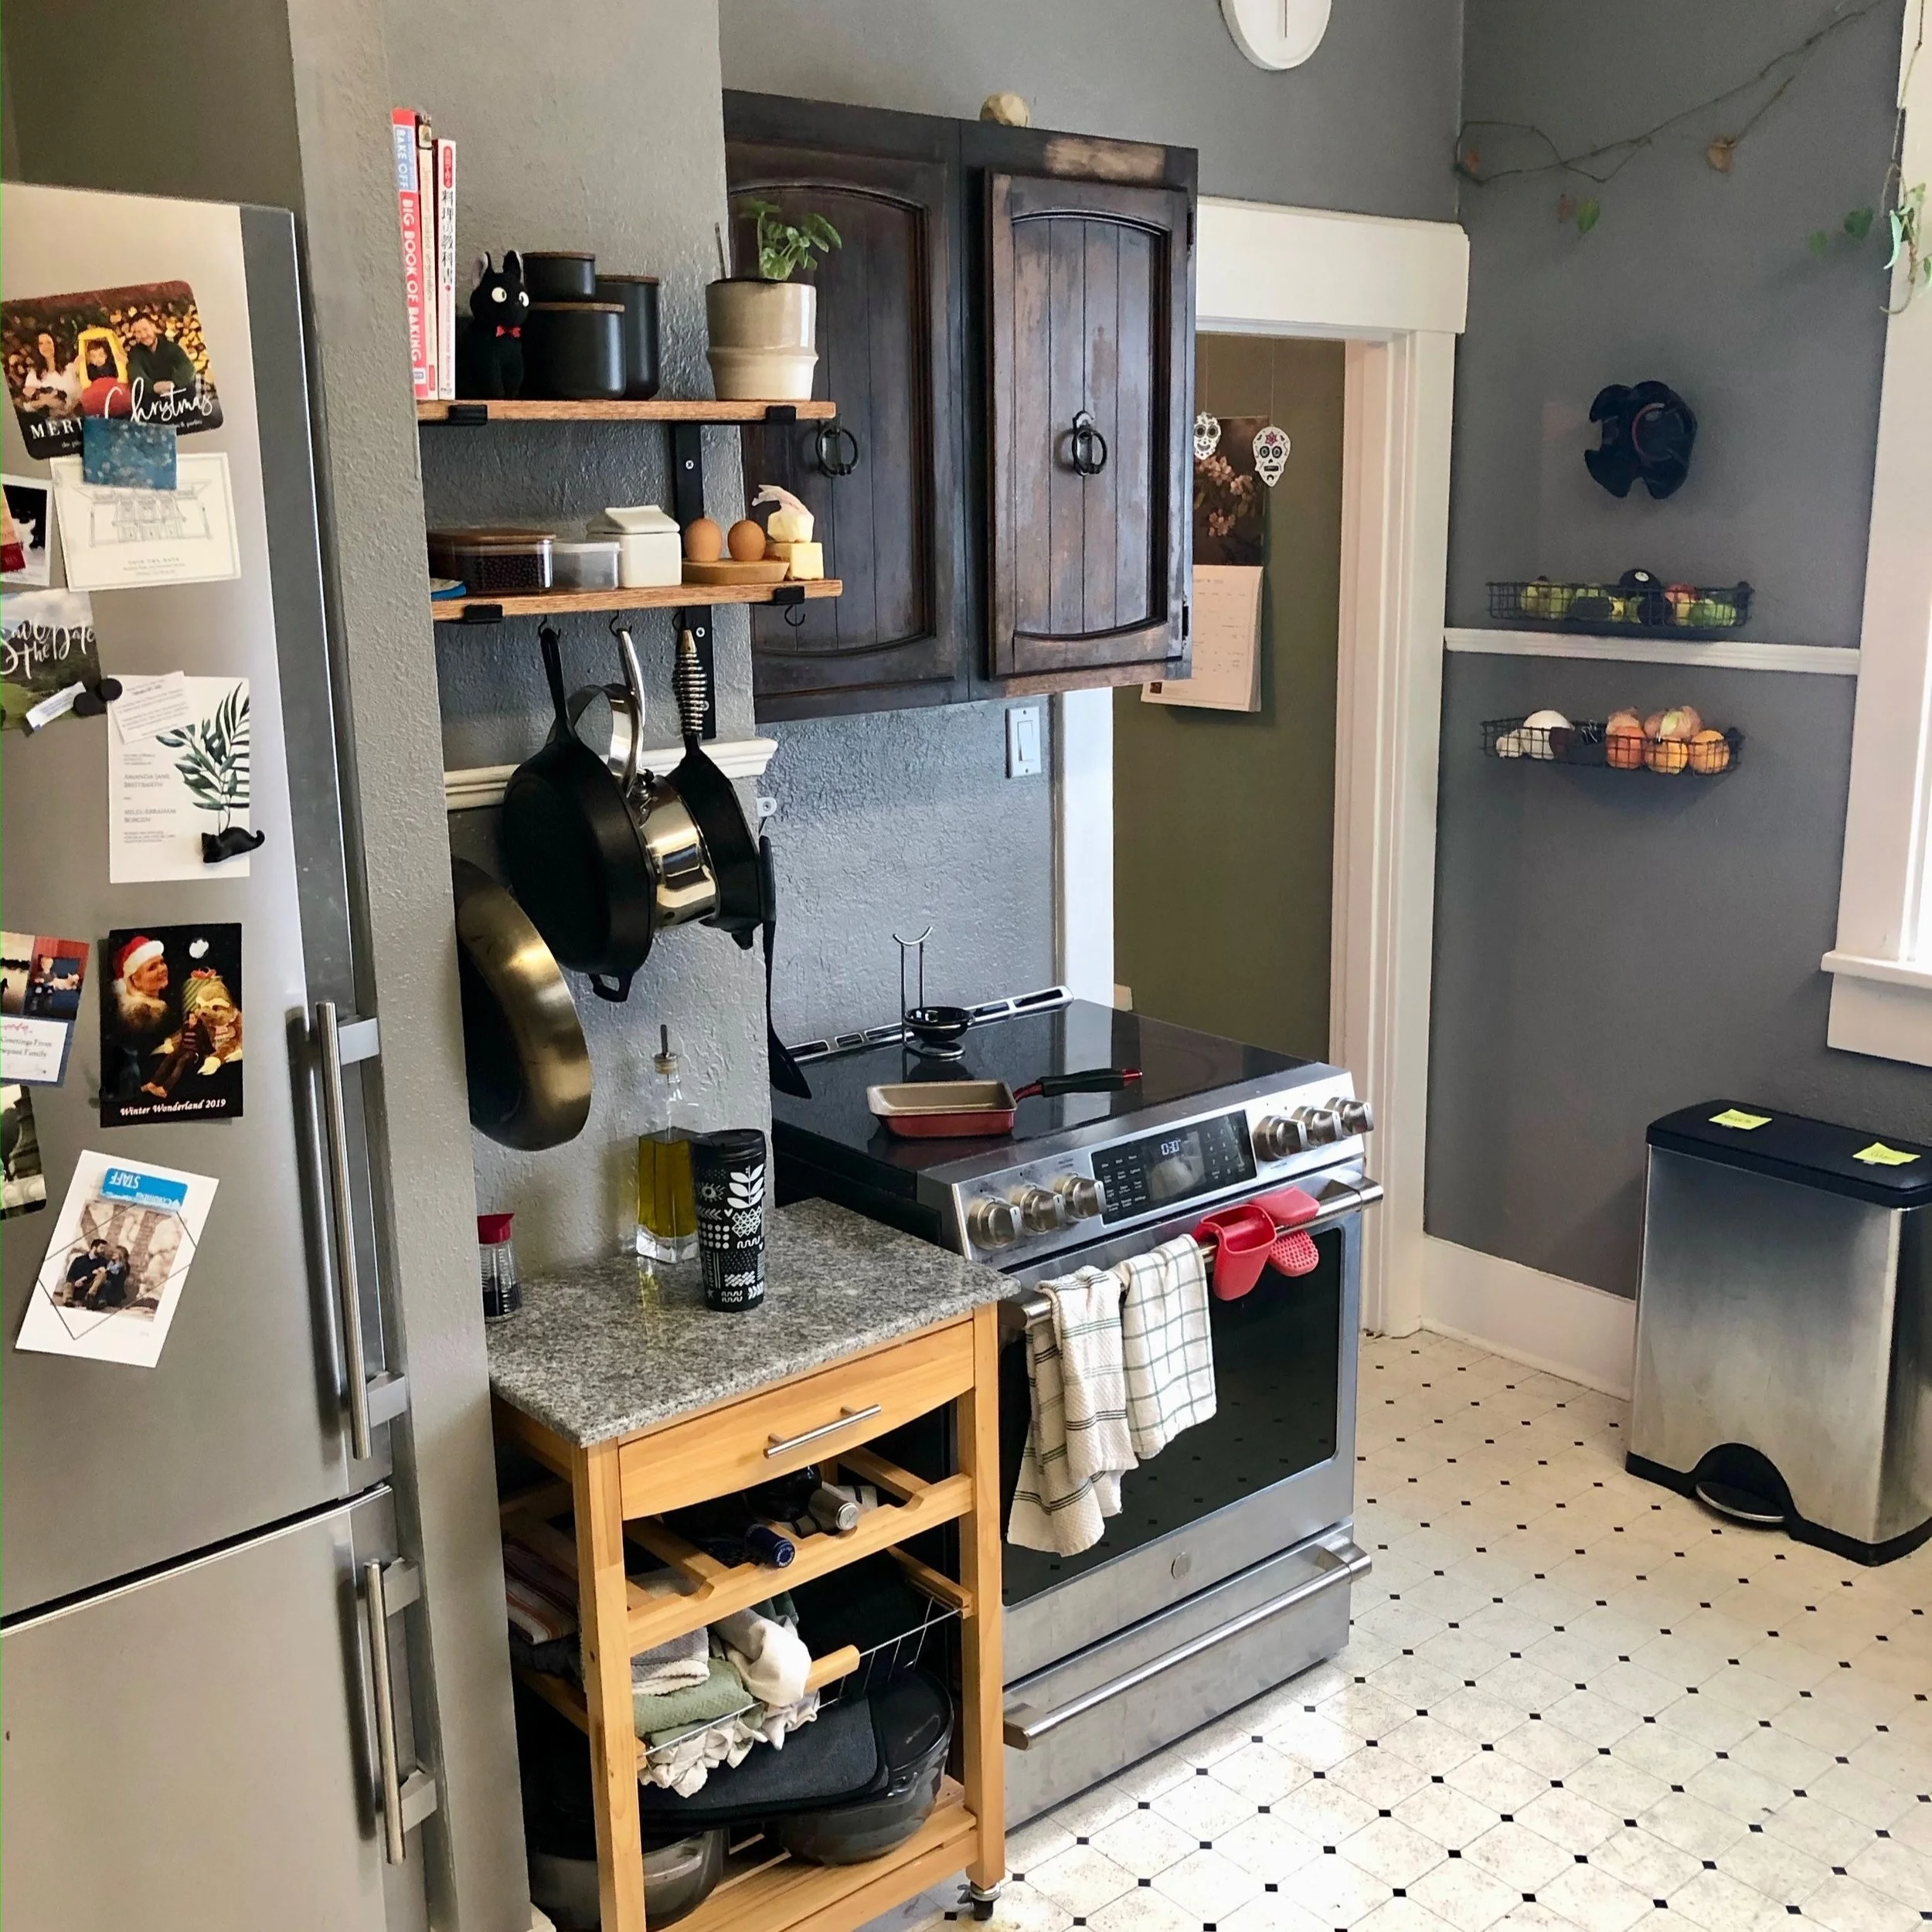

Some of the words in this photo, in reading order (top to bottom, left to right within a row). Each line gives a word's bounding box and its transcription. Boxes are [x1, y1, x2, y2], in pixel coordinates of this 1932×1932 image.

[396, 128, 407, 160] BAKE
[398, 163, 409, 190] OFF
[402, 199, 415, 226] BIG
[403, 231, 417, 278] BOOK
[406, 280, 419, 304] OF
[408, 306, 422, 362] BAKING
[120, 1106, 151, 1116] Winter
[152, 1099, 205, 1113] Wonderland
[205, 1098, 226, 1108] 2019
[108, 1171, 141, 1189] STAFF
